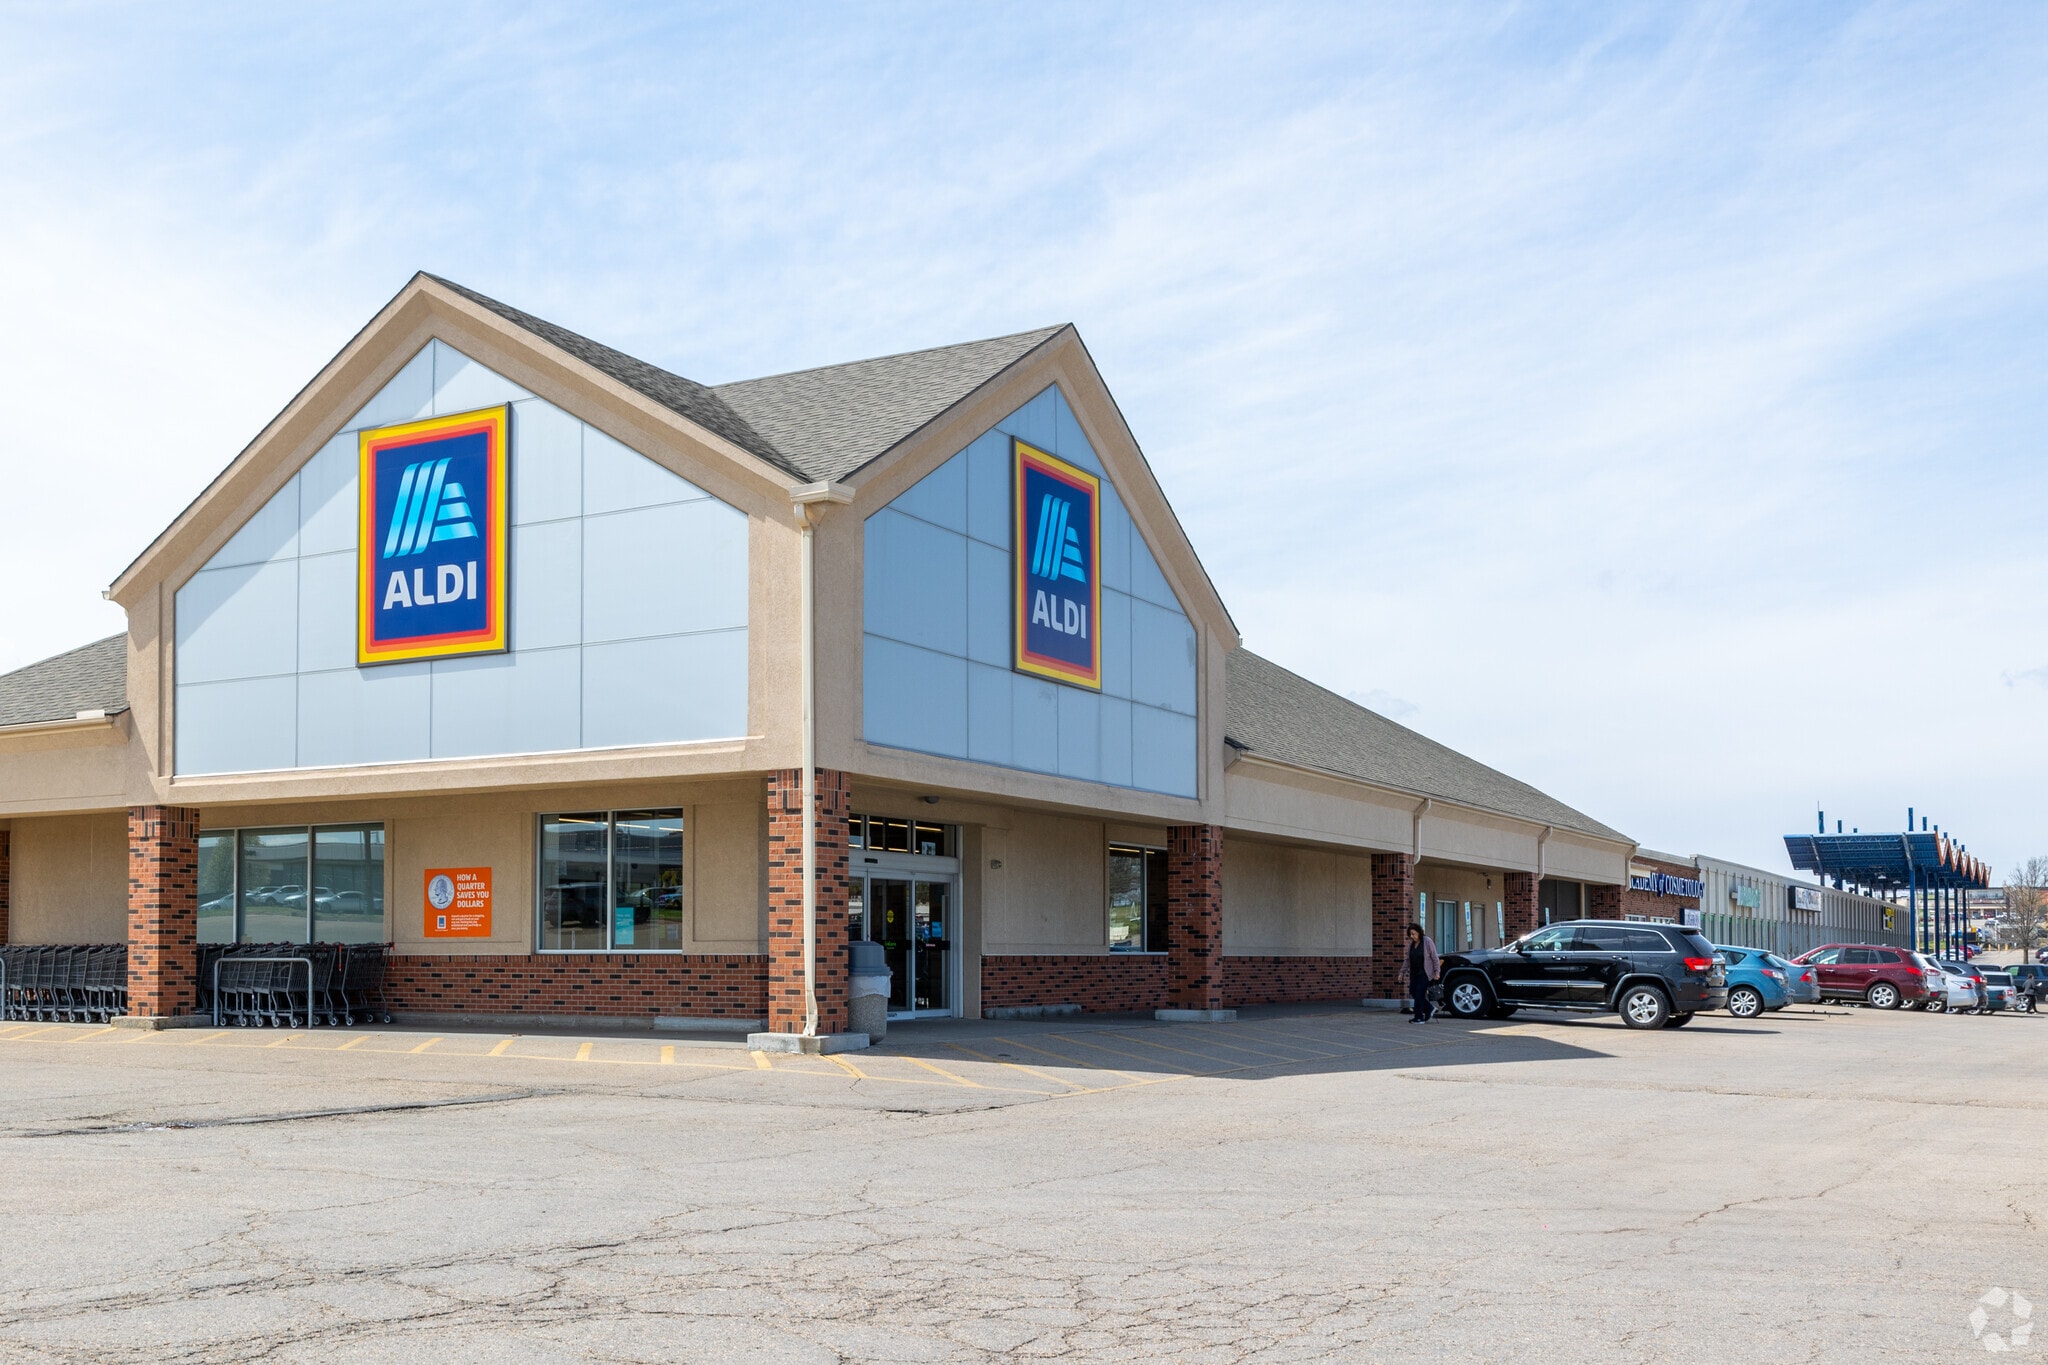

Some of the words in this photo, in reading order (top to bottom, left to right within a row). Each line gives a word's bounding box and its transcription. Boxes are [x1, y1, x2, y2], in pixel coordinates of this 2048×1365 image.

[383, 561, 477, 610] ALDI
[1032, 589, 1086, 639] ALDI
[472, 873, 477, 881] A
[457, 882, 485, 891] QUARTER
[1631, 872, 1658, 892] CADEMY
[1665, 875, 1705, 898] COSMETOLOGY
[457, 891, 475, 899] SAVES
[476, 891, 489, 899] YOU
[457, 900, 484, 908] DOLLARS
